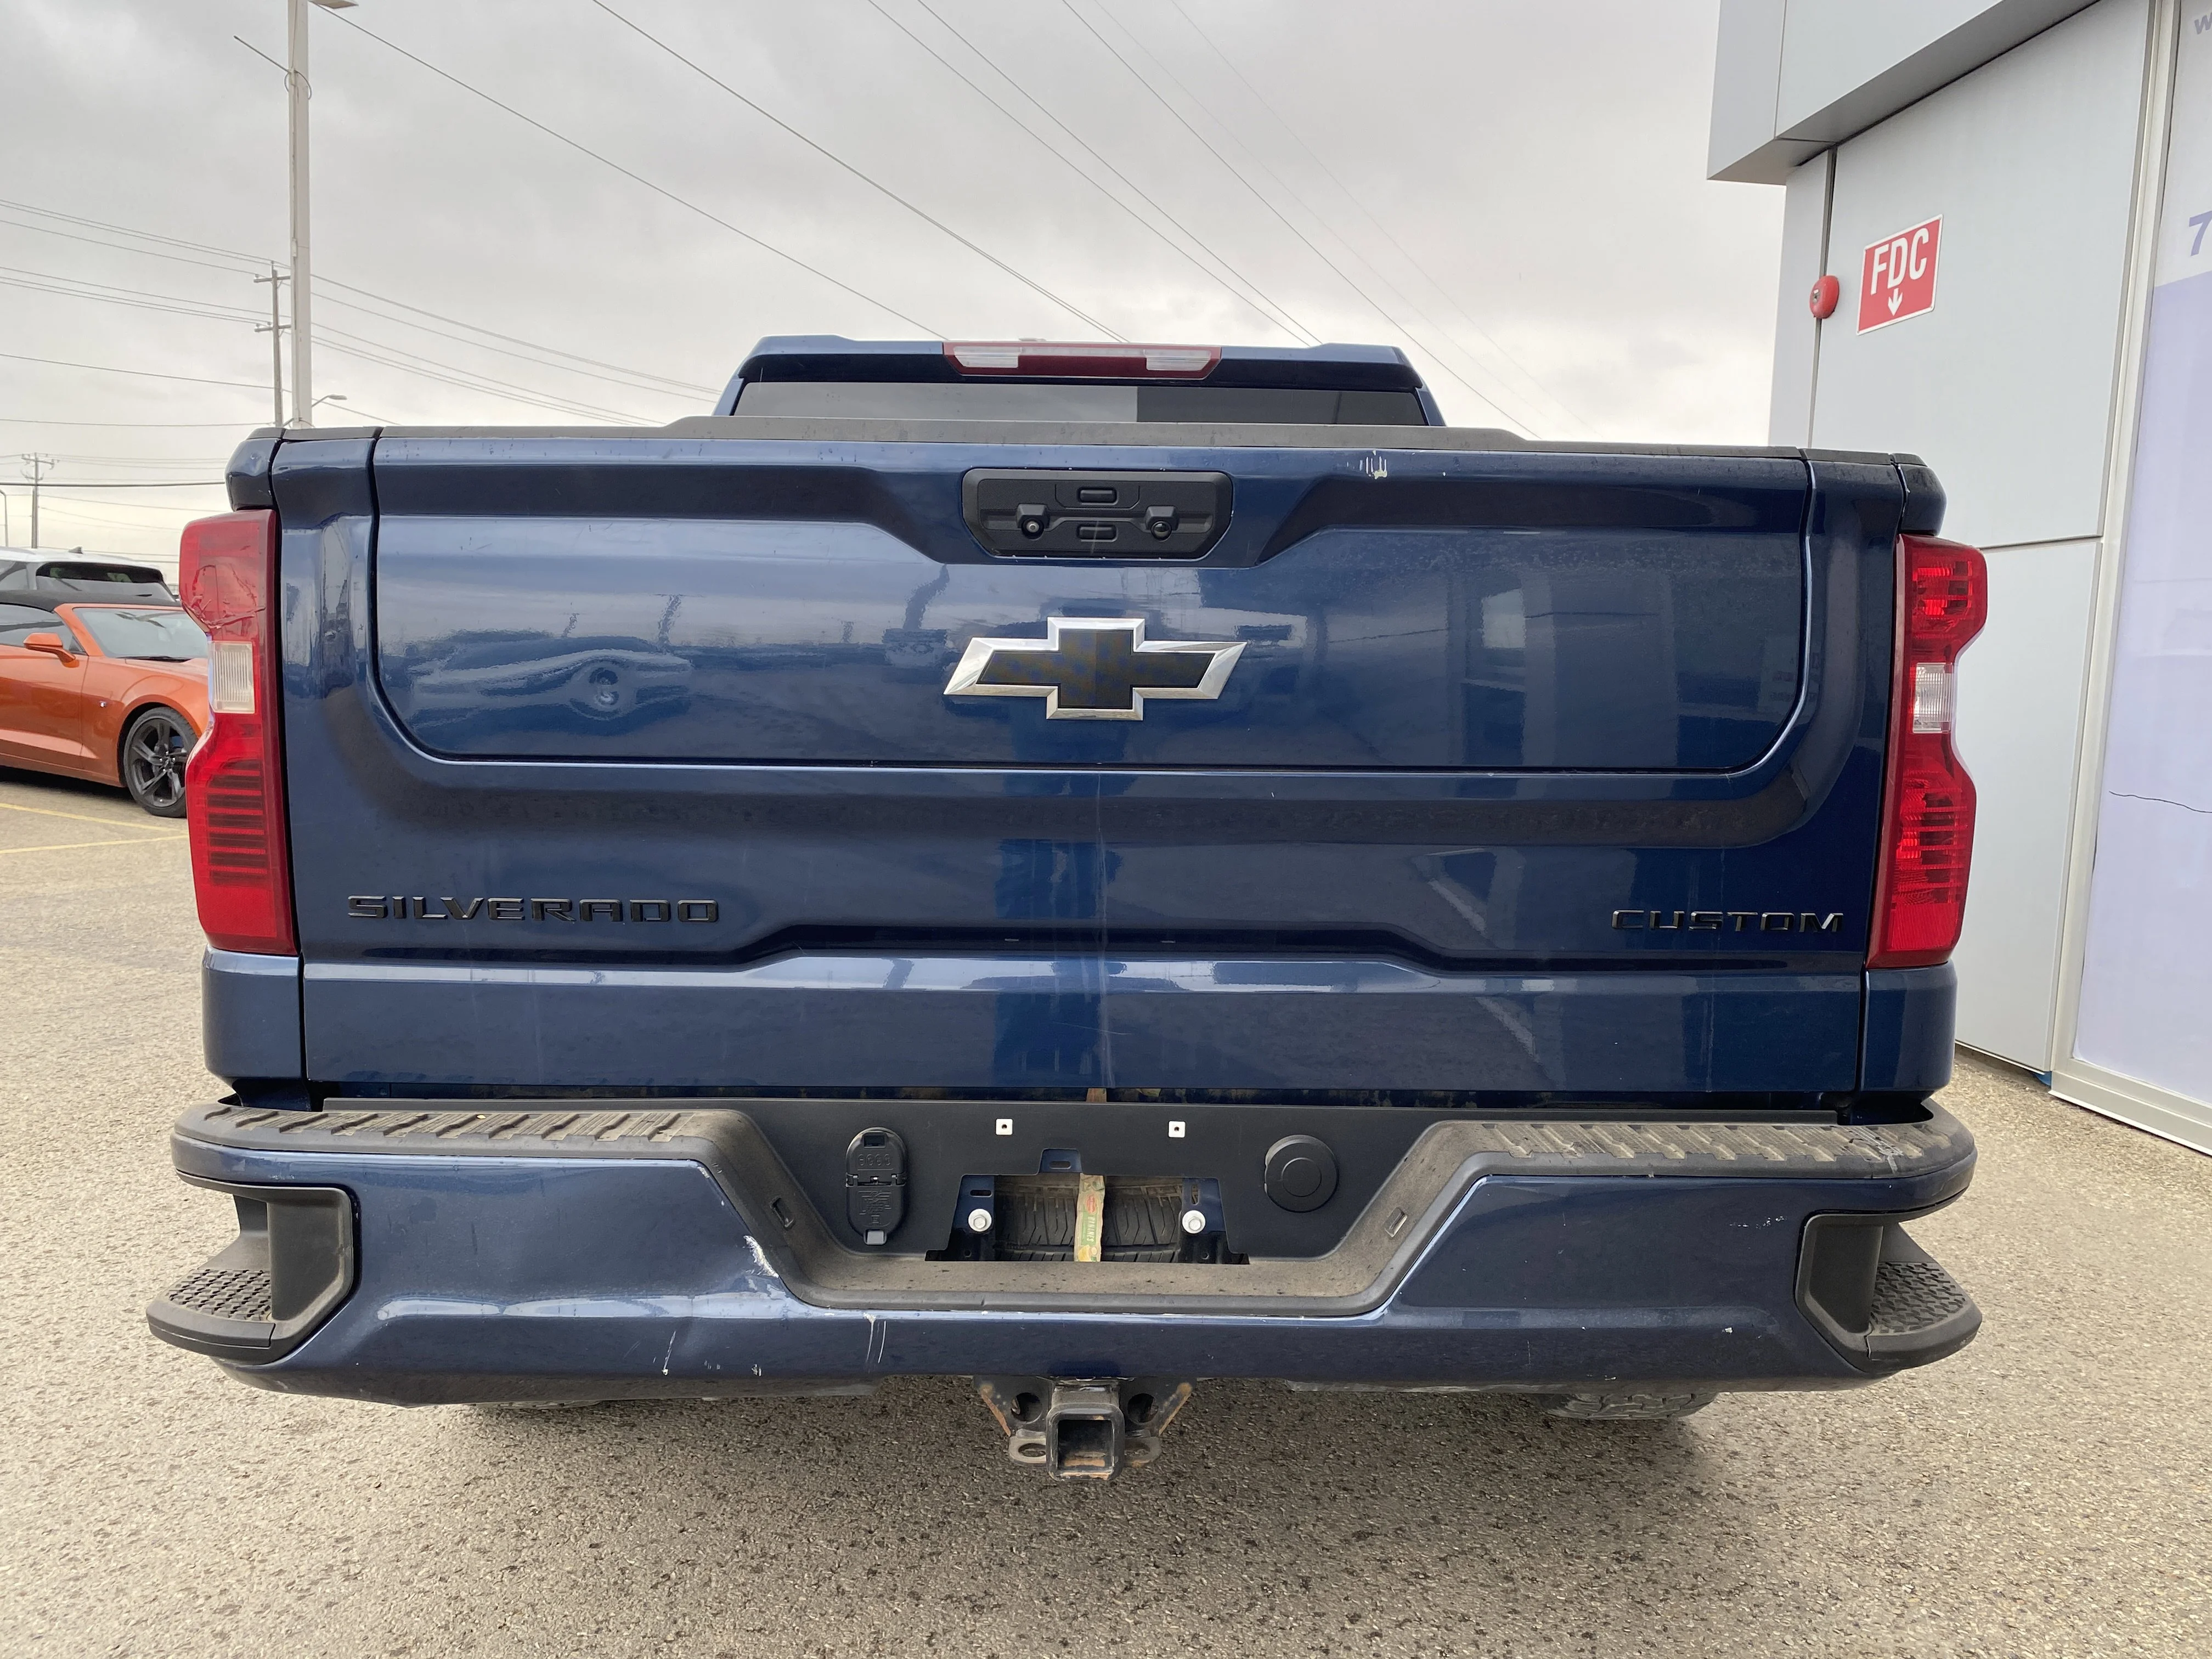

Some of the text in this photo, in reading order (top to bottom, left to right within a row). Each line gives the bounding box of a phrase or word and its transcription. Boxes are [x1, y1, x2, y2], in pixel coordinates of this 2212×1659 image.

[1871, 228, 1929, 296] FDC
[347, 895, 719, 922] SILVERADO
[1611, 910, 1844, 933] CUSTOM
